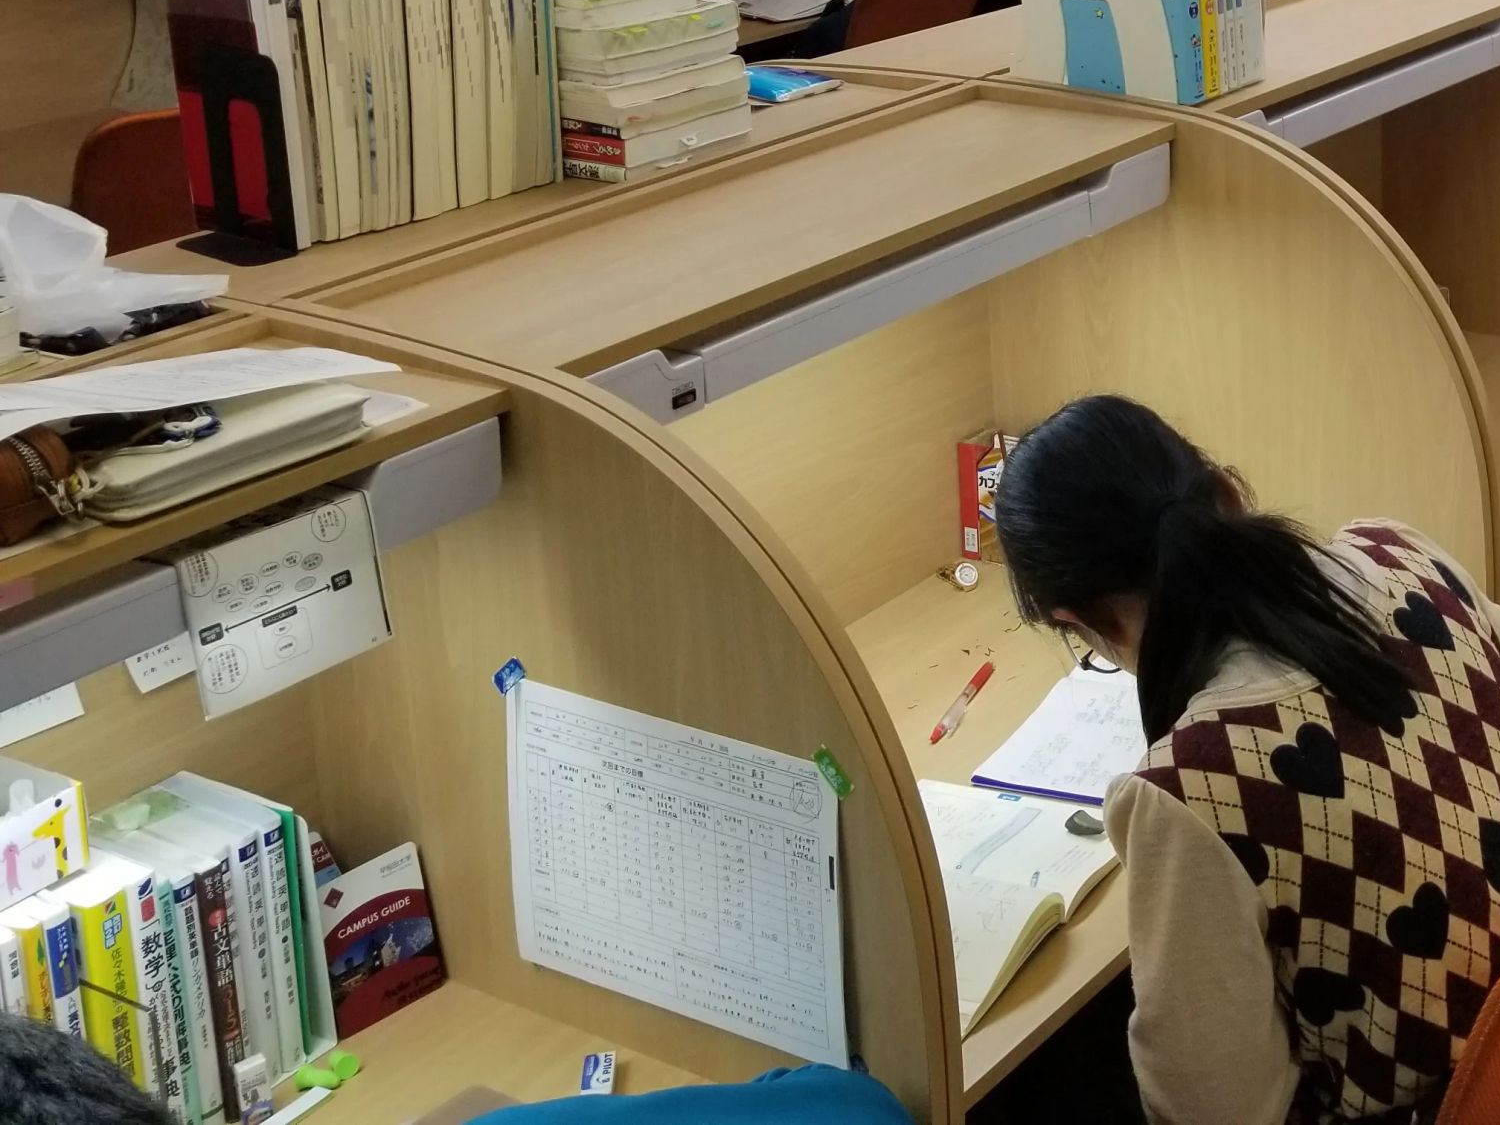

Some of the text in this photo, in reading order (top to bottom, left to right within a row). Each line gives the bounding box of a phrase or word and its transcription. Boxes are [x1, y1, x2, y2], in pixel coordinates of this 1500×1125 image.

[601, 760, 644, 778] 次回までの目標
[337, 896, 411, 939] CAMPUS GUIDE
[141, 931, 165, 979] 数学
[211, 922, 234, 987] 古文単語
[602, 1053, 613, 1075] PILOT
